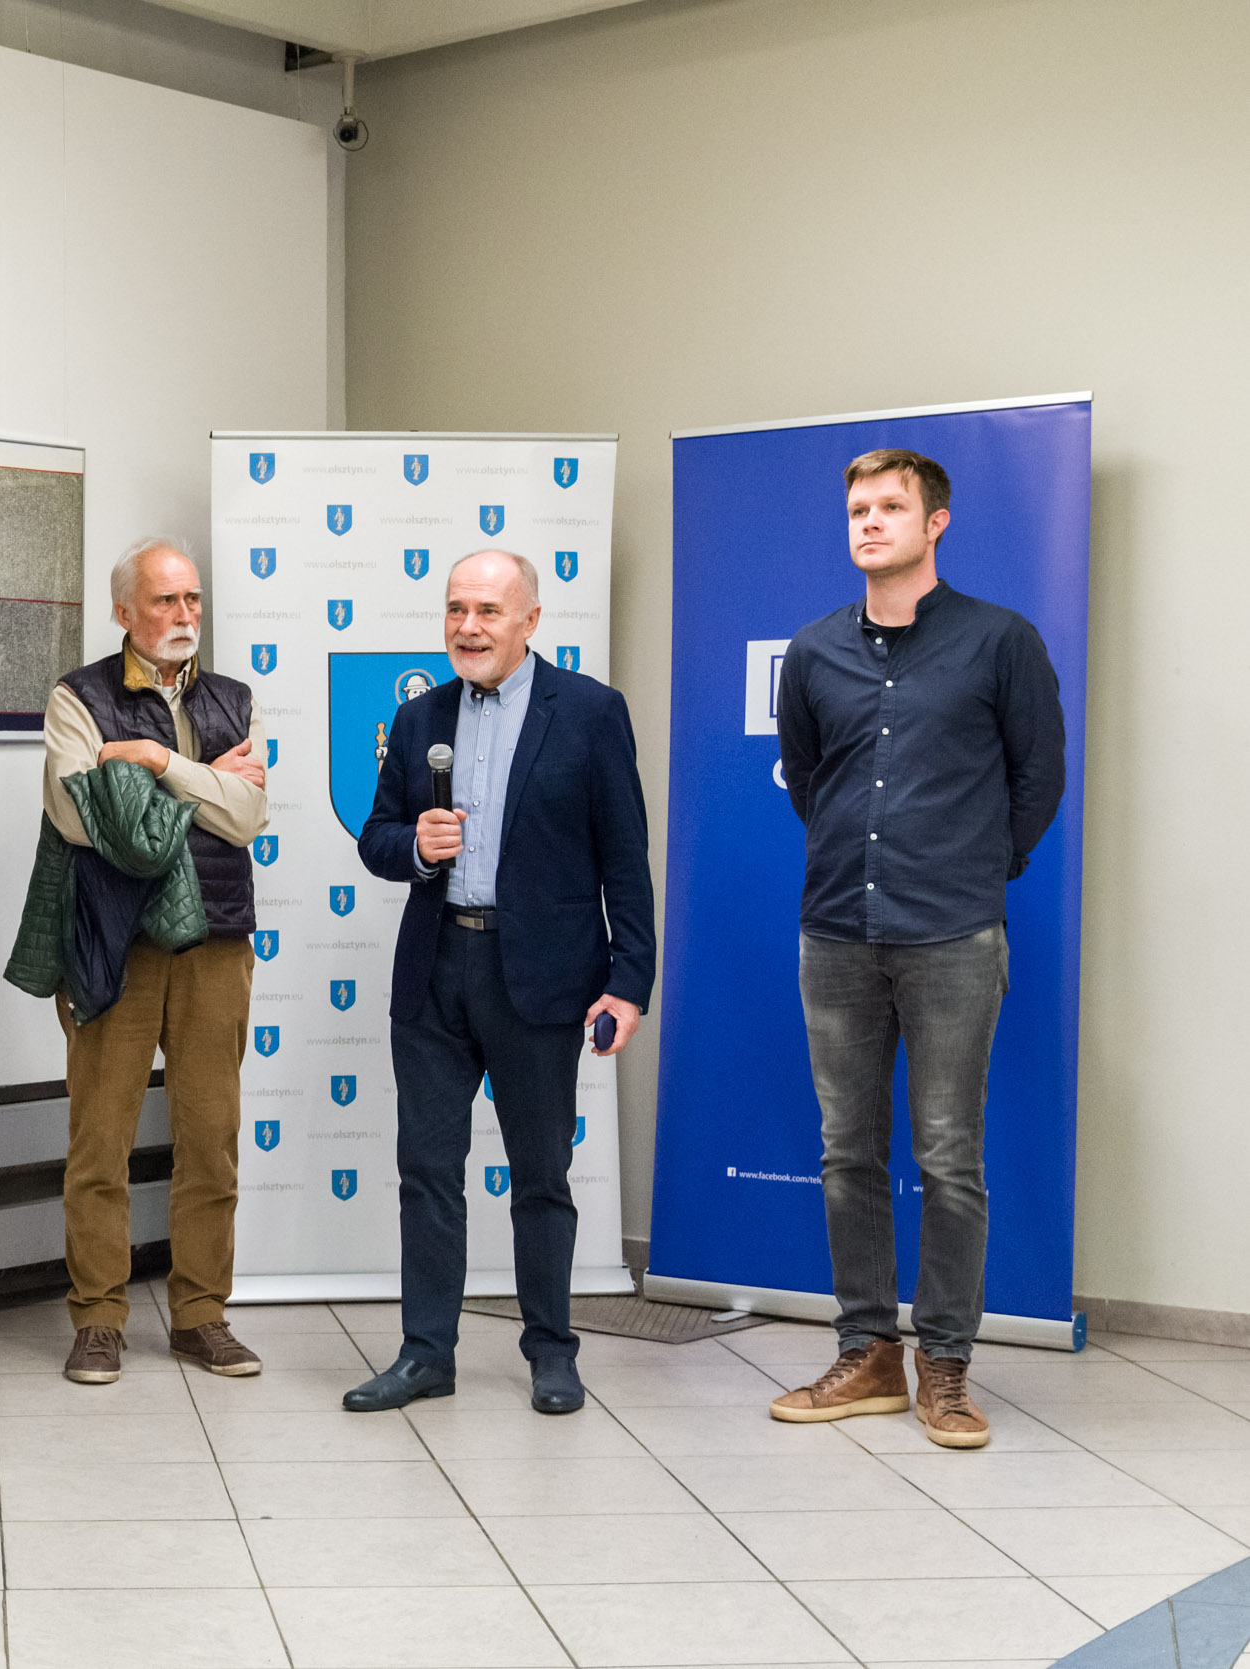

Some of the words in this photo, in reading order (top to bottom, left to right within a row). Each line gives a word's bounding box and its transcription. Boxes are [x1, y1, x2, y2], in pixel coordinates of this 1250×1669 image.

[302, 464, 377, 476] www.olsztyn.eu
[454, 465, 529, 477] www.olsztyn.eu
[224, 514, 301, 526] www.olsztyn.eu
[379, 514, 454, 526] www.olsztyn.eu
[531, 515, 600, 528] www.olsztyn.eu
[302, 559, 378, 571] www.olsztyn.eu
[225, 609, 302, 621] www.olsztyn.eu
[380, 608, 444, 621] www.olsztyn.
[540, 609, 601, 621] ww.olsztyn.eu
[260, 705, 302, 717] lsztyn.eu
[269, 801, 302, 812] ztyn.eu
[305, 938, 381, 951] www.olsztyn.eu
[306, 1034, 382, 1046] www.olsztyn.eu
[240, 1086, 305, 1098] ww.olsztyn.eu
[307, 1129, 382, 1141] www.olsztyn.eu
[739, 1170, 823, 1185] www.facebook.com/tele
[238, 1181, 305, 1193] ww.olsztyn.eu
